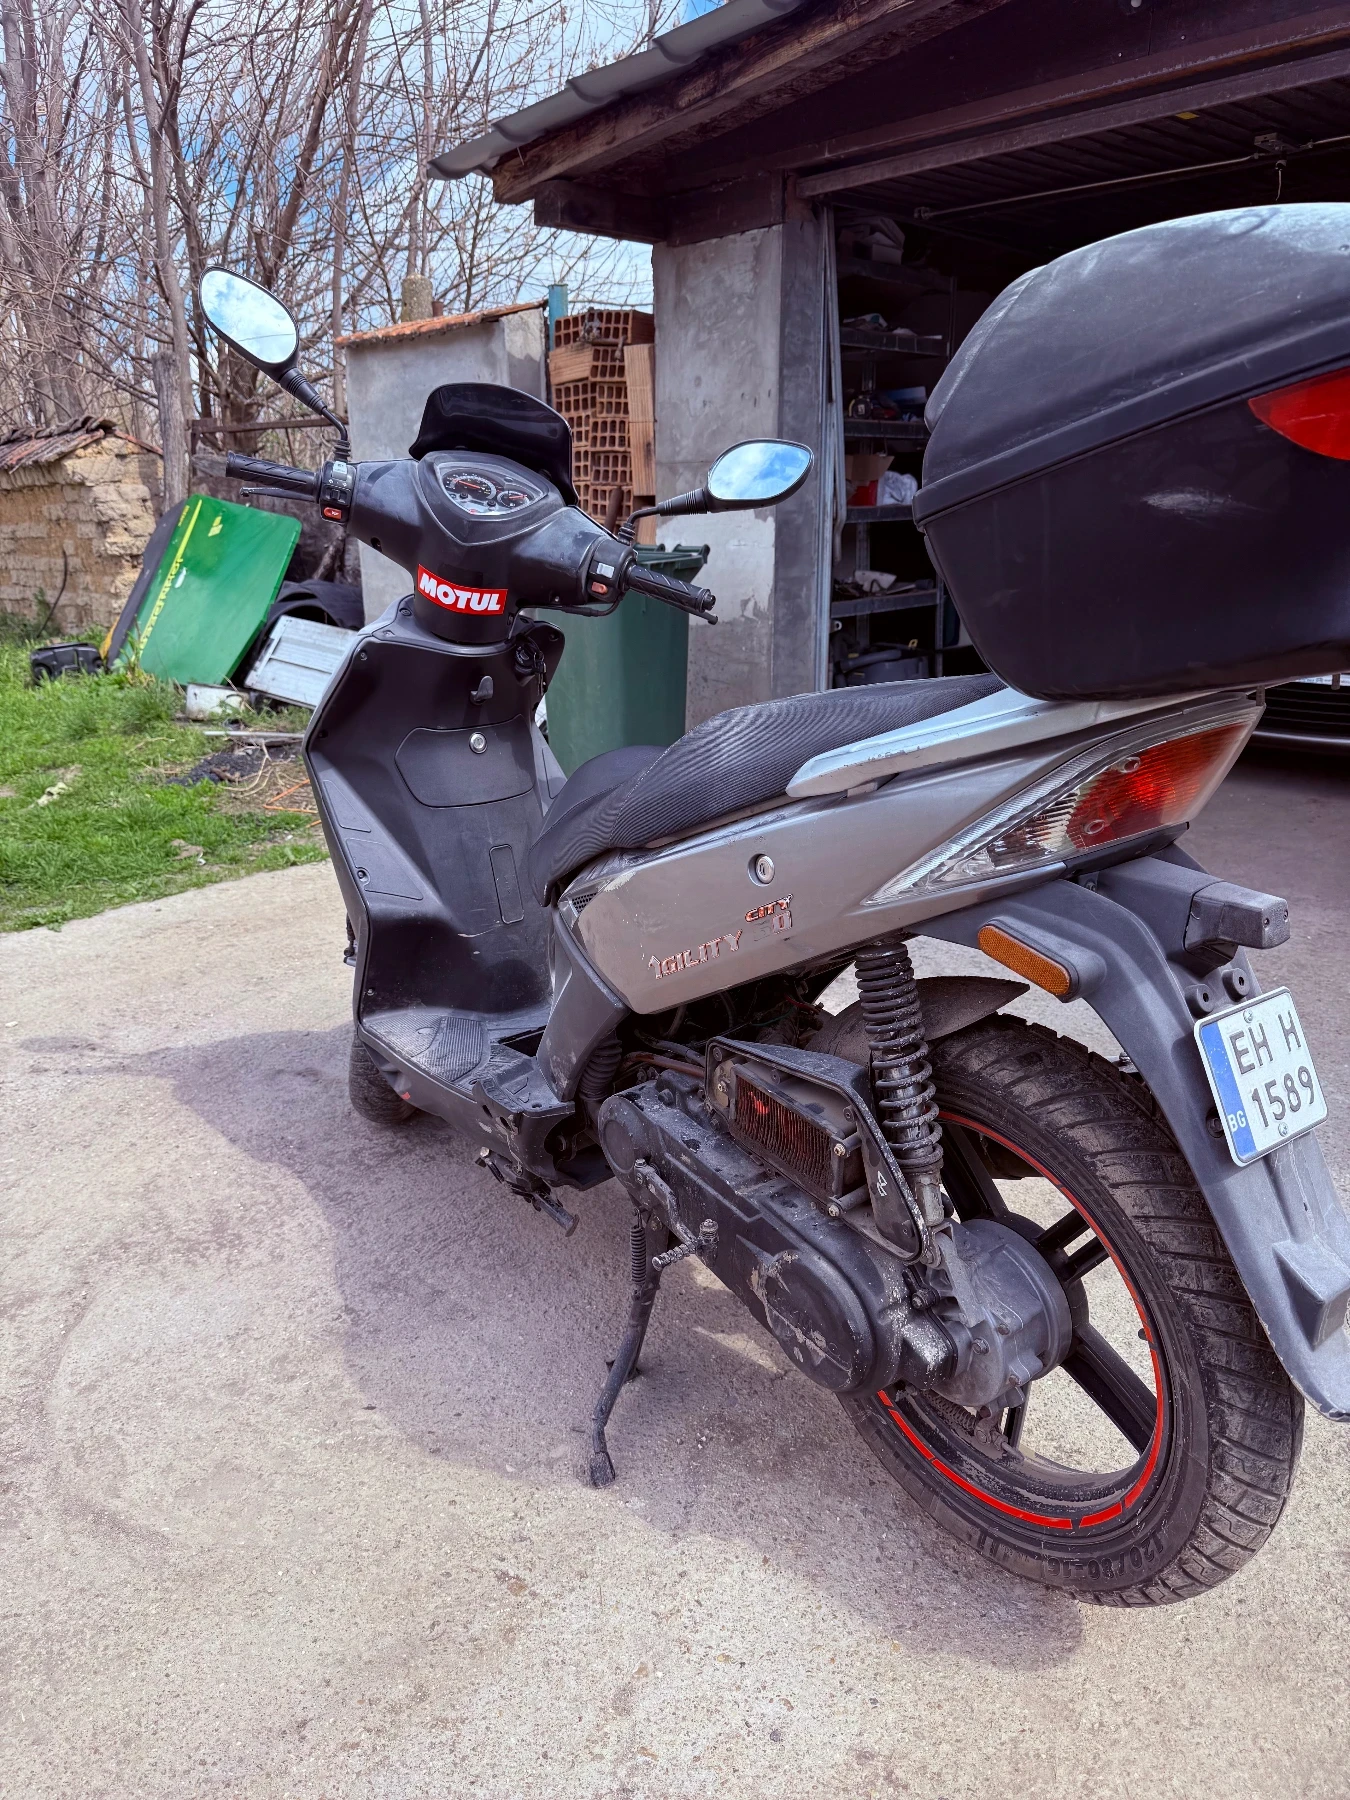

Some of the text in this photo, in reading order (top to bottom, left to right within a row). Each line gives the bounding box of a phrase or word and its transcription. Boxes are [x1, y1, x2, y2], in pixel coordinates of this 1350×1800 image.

[420, 573, 501, 611] MOTUL
[745, 894, 793, 922] CITY
[1229, 1010, 1302, 1074] EH H
[1251, 1065, 1314, 1127] 1589
[1227, 1111, 1247, 1132] BG
